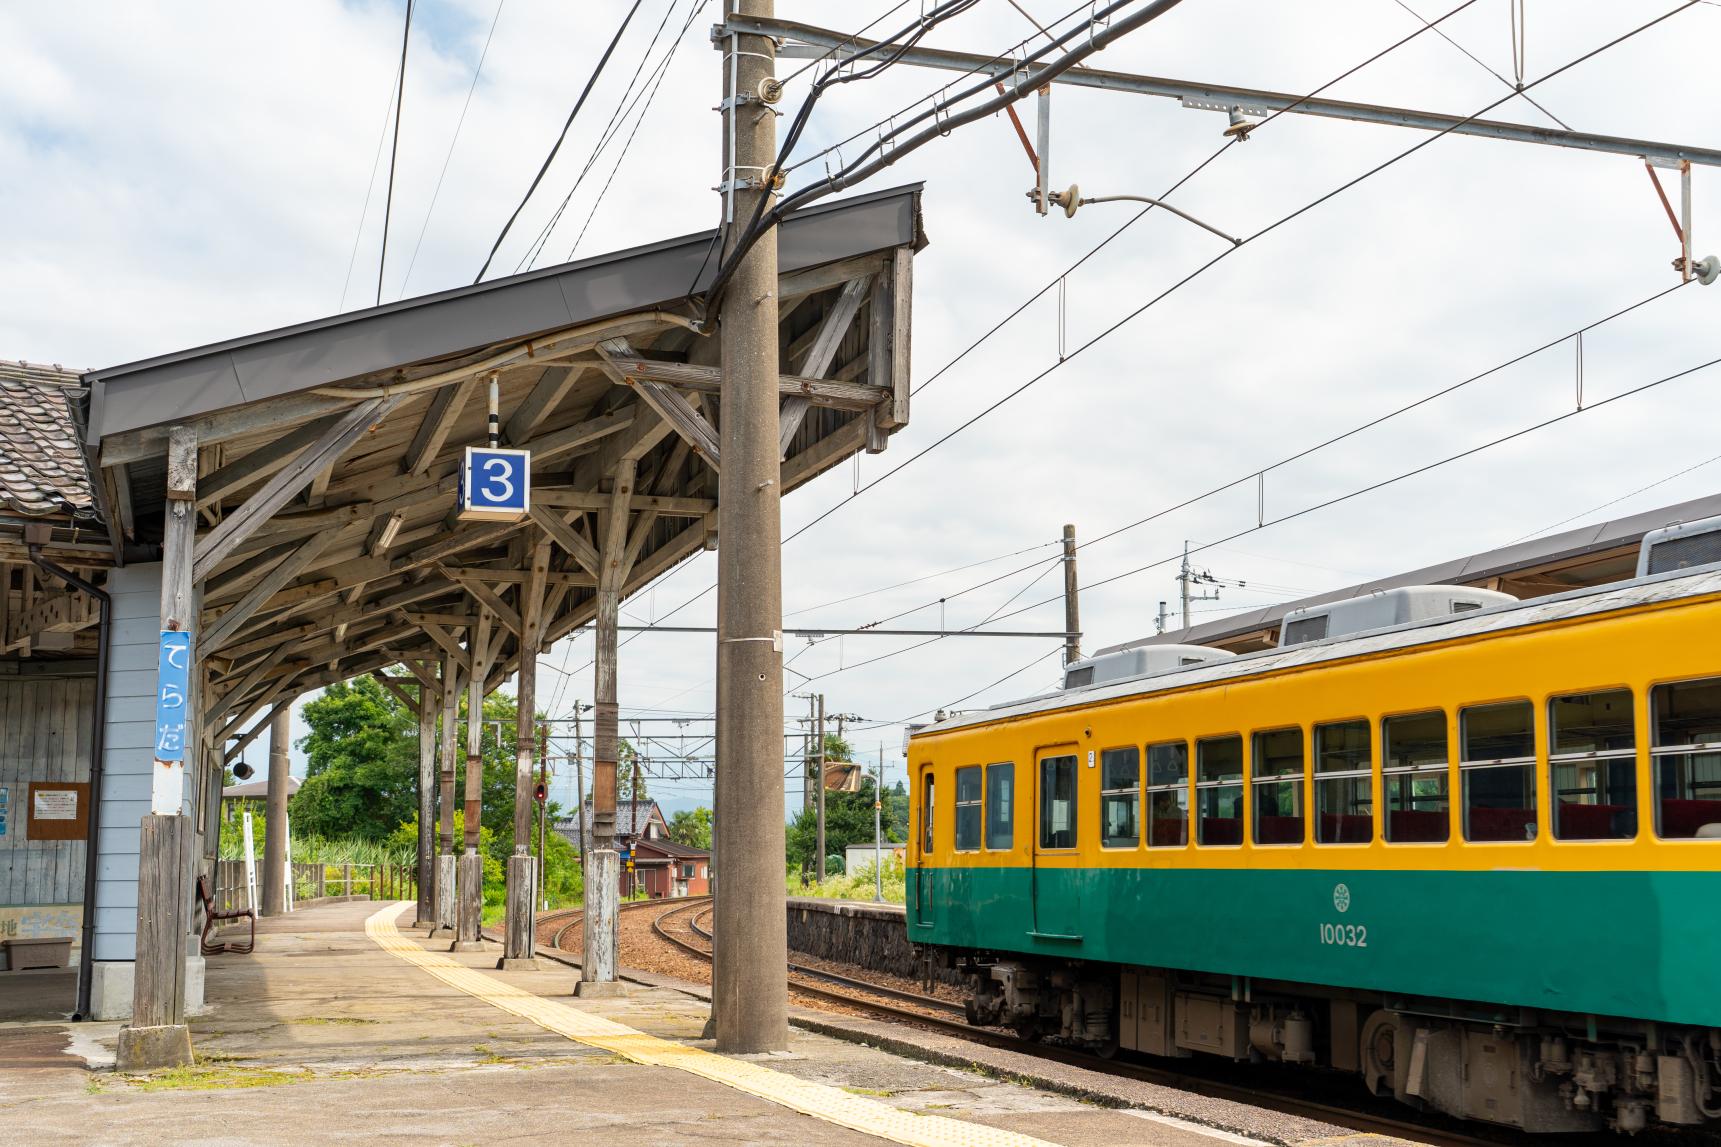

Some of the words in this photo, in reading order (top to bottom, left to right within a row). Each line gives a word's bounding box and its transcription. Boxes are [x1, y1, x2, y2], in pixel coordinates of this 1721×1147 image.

[481, 458, 514, 502] 3
[159, 640, 187, 751] てらだ
[1320, 923, 1367, 947] 10032
